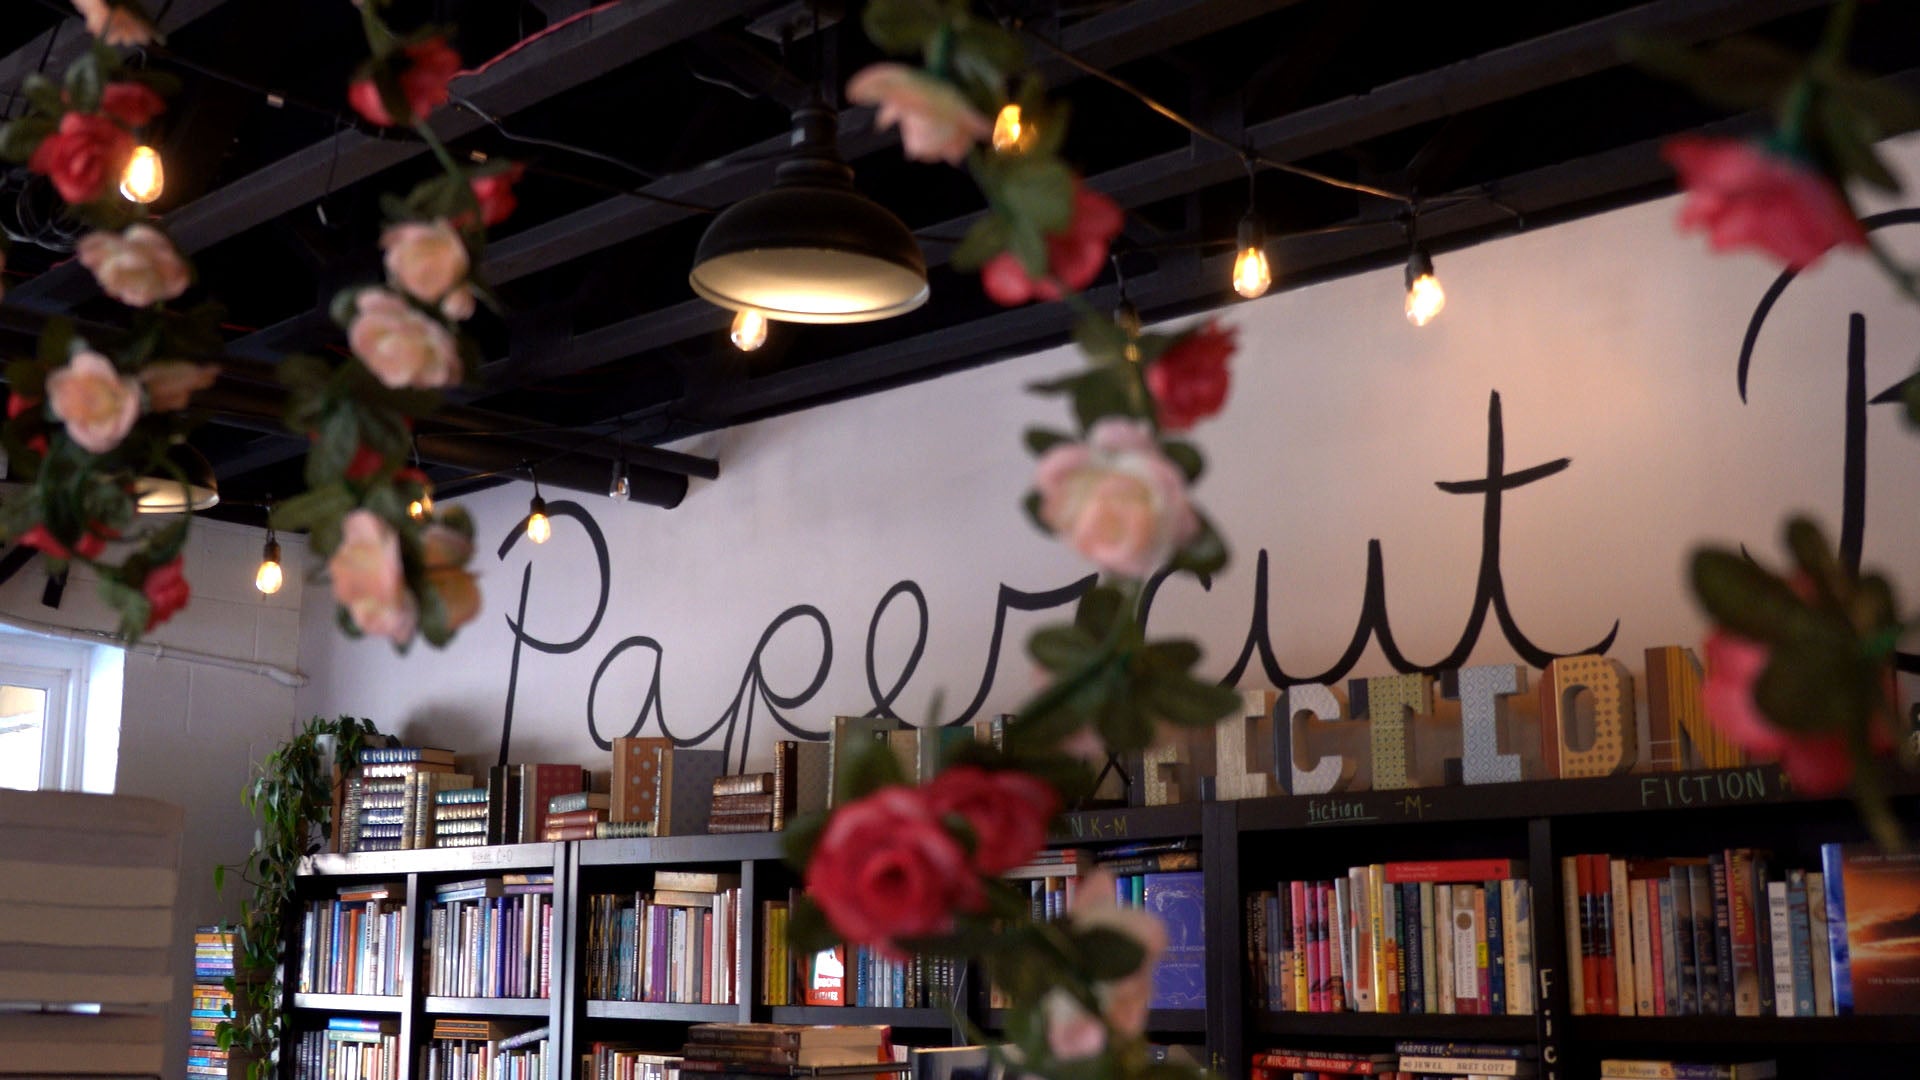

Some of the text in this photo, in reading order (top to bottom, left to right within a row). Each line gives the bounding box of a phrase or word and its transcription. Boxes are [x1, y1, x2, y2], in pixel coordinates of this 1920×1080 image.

[1640, 768, 1766, 807] FICTION
[1307, 800, 1364, 821] fiction
[1091, 815, 1128, 837] K-M
[1488, 916, 1497, 938] Girls
[1397, 1043, 1444, 1055] HARPER LEE
[1413, 1060, 1443, 1069] JEWEL
